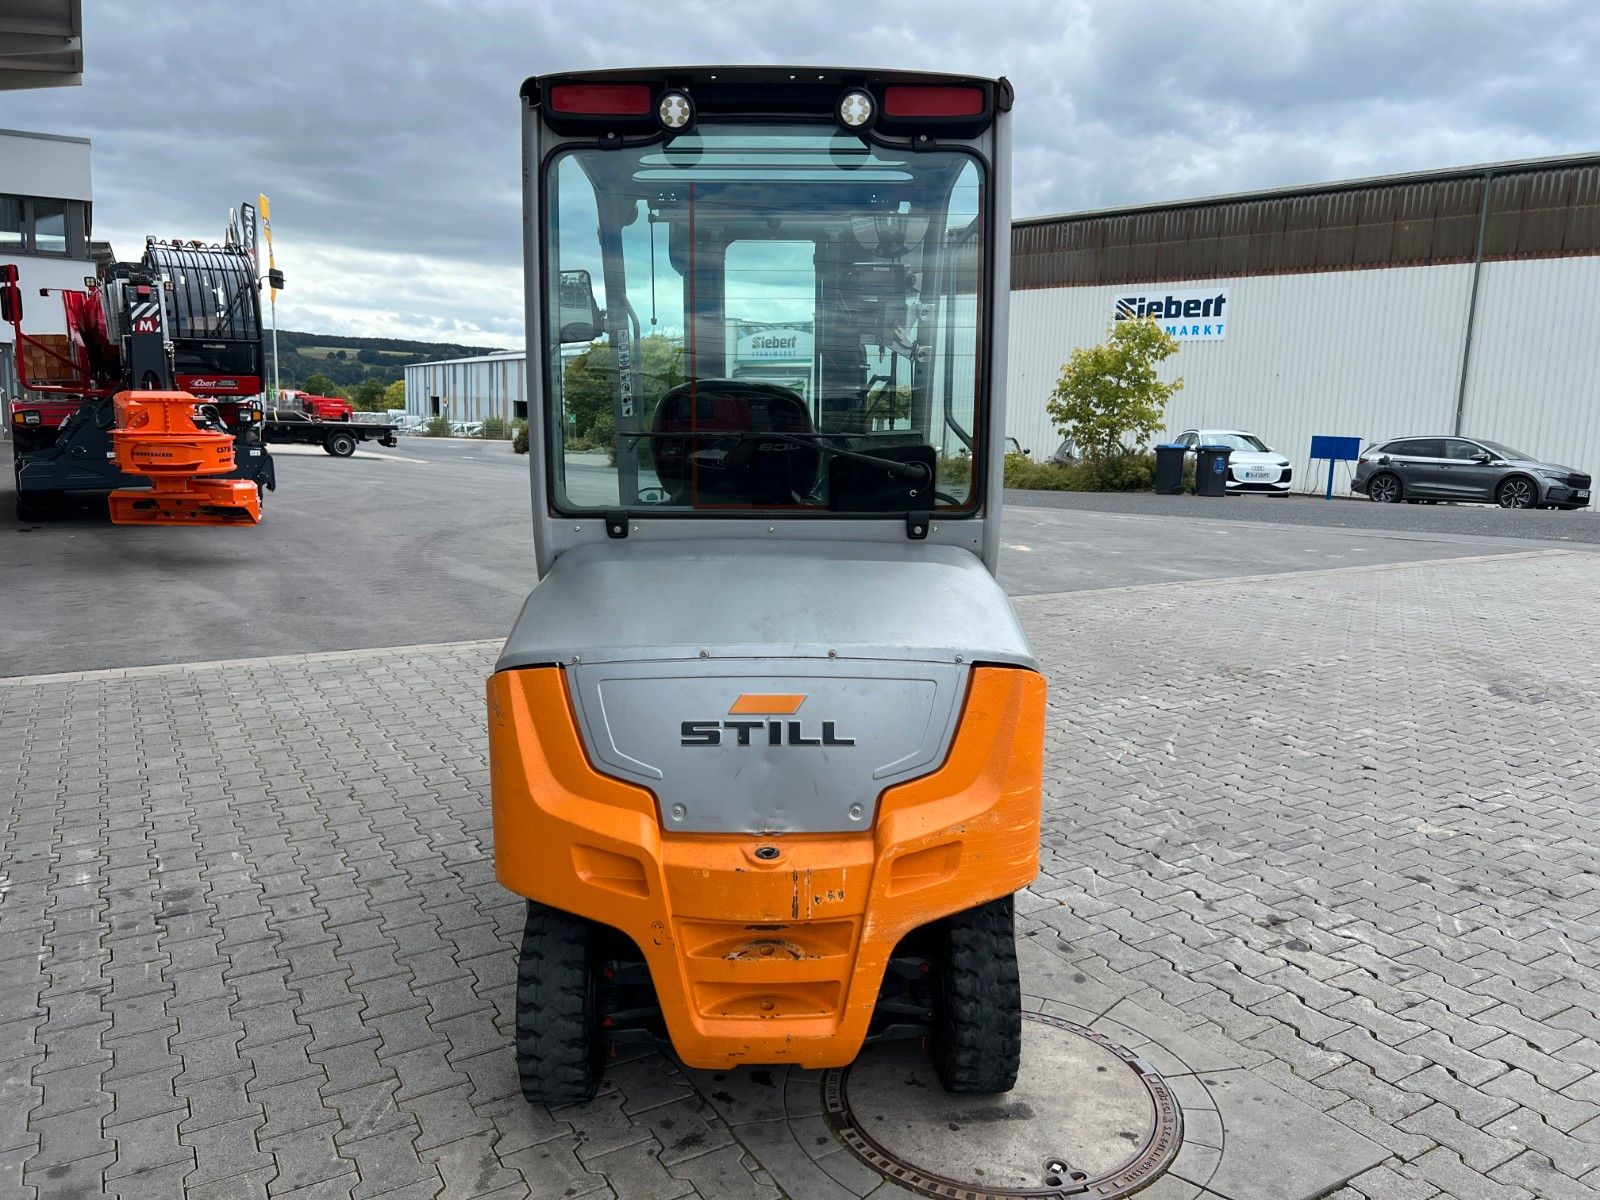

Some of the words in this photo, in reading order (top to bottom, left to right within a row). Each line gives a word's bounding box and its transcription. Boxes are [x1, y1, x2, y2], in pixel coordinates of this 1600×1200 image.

[1115, 293, 1226, 320] Siebert
[139, 320, 154, 332] M
[1165, 325, 1224, 336] MARKT
[752, 336, 797, 349] Siebert
[681, 720, 856, 747] STILL
